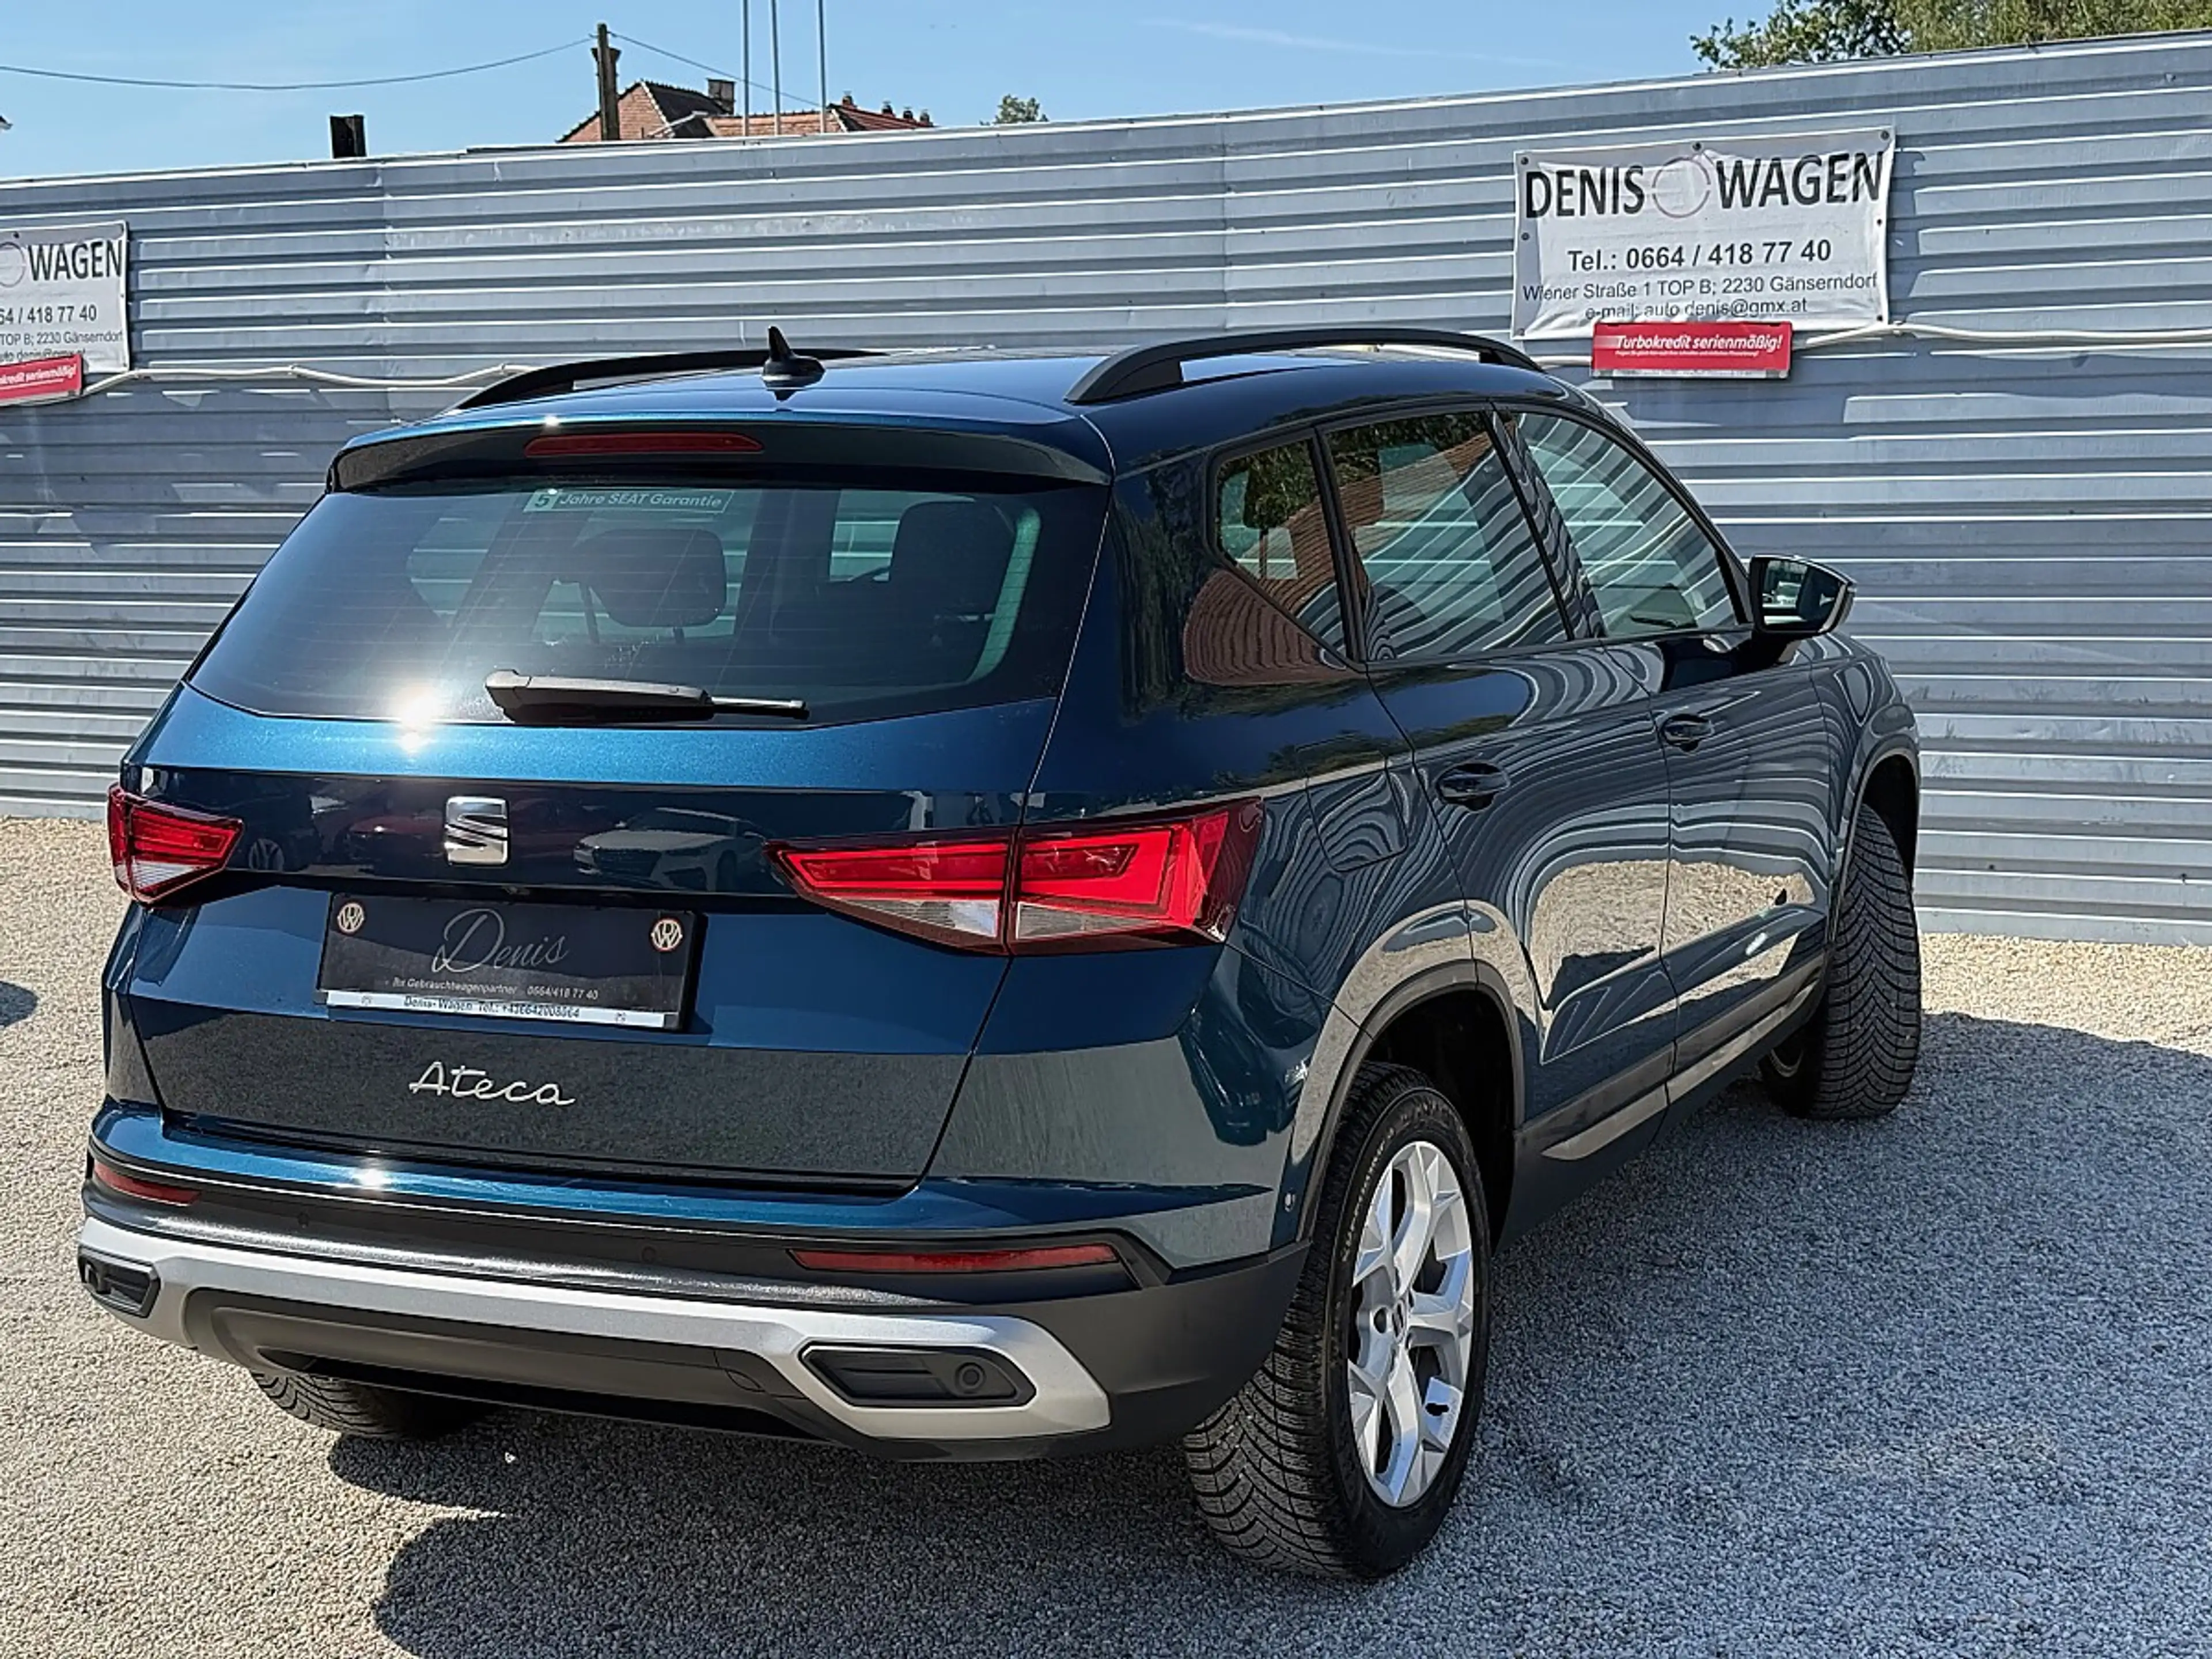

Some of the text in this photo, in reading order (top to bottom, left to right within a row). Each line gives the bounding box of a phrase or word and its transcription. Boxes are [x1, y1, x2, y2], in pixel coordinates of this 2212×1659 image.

[1526, 151, 1884, 218] DENIS WAGEN
[28, 240, 122, 281] WAGEN
[1567, 240, 1831, 271] Tel.: 0664 / 418 77 40
[1522, 271, 1877, 301] Wiener Straße 1 TOP B; 2230 Gänserndorf
[18, 307, 22, 324] /
[27, 306, 52, 323] 418
[58, 306, 74, 323] 77
[79, 304, 97, 321] 40
[36, 331, 62, 344] 2230
[1617, 334, 1783, 353] Turbokredit serienmäßig!
[534, 493, 722, 507] 5 Jahre SEAT Garantie
[432, 908, 569, 972] Denis
[408, 1060, 575, 1105] Ateca
